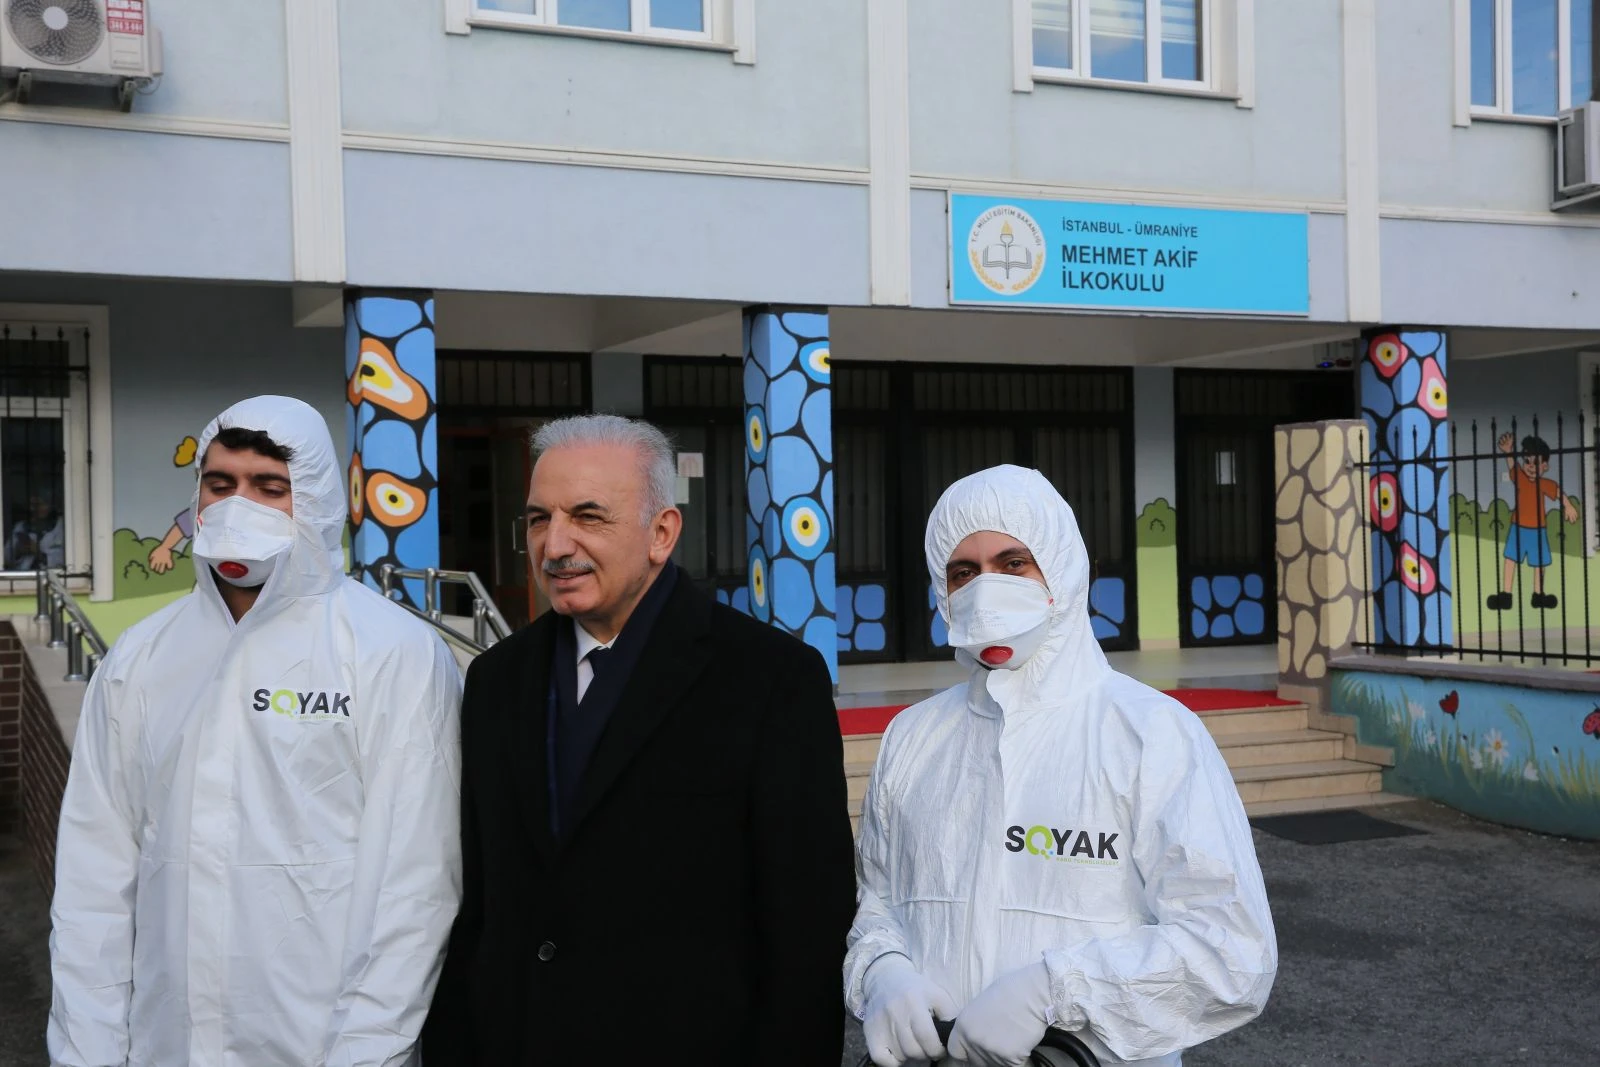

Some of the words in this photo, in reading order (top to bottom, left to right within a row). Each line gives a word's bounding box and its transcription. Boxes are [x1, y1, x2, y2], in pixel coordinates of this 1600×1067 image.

[993, 207, 1016, 217] EĞİTİM
[1062, 216, 1124, 234] İSTANBUL
[1135, 221, 1198, 238] ÜMRANİYE
[1062, 244, 1148, 266] MEHMET
[1153, 246, 1198, 268] AKİF
[1062, 266, 1164, 292] İLKOKULU
